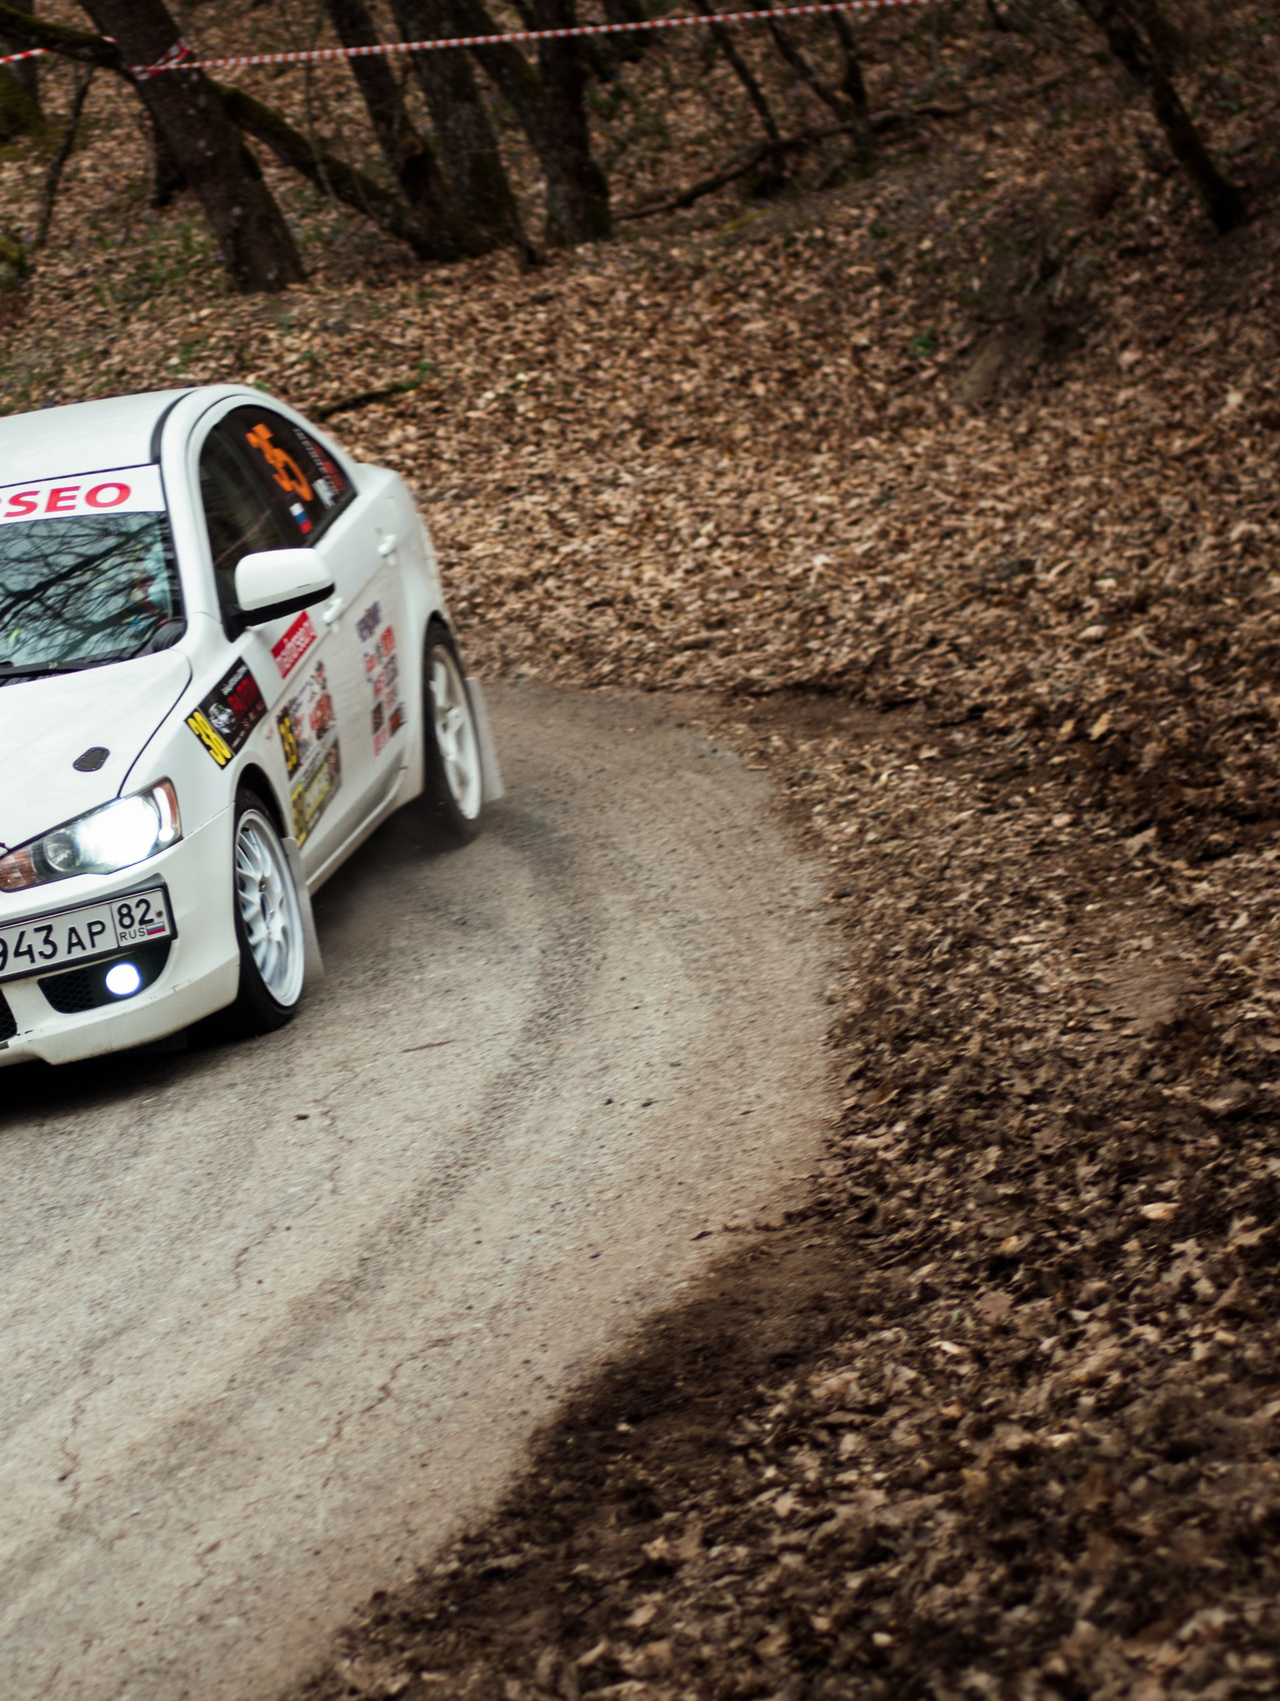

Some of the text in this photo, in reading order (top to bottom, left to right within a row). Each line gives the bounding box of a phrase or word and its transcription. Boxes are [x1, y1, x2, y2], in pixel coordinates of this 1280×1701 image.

[187, 711, 232, 766] 38
[117, 898, 154, 929] 82
[120, 927, 146, 942] RUS
